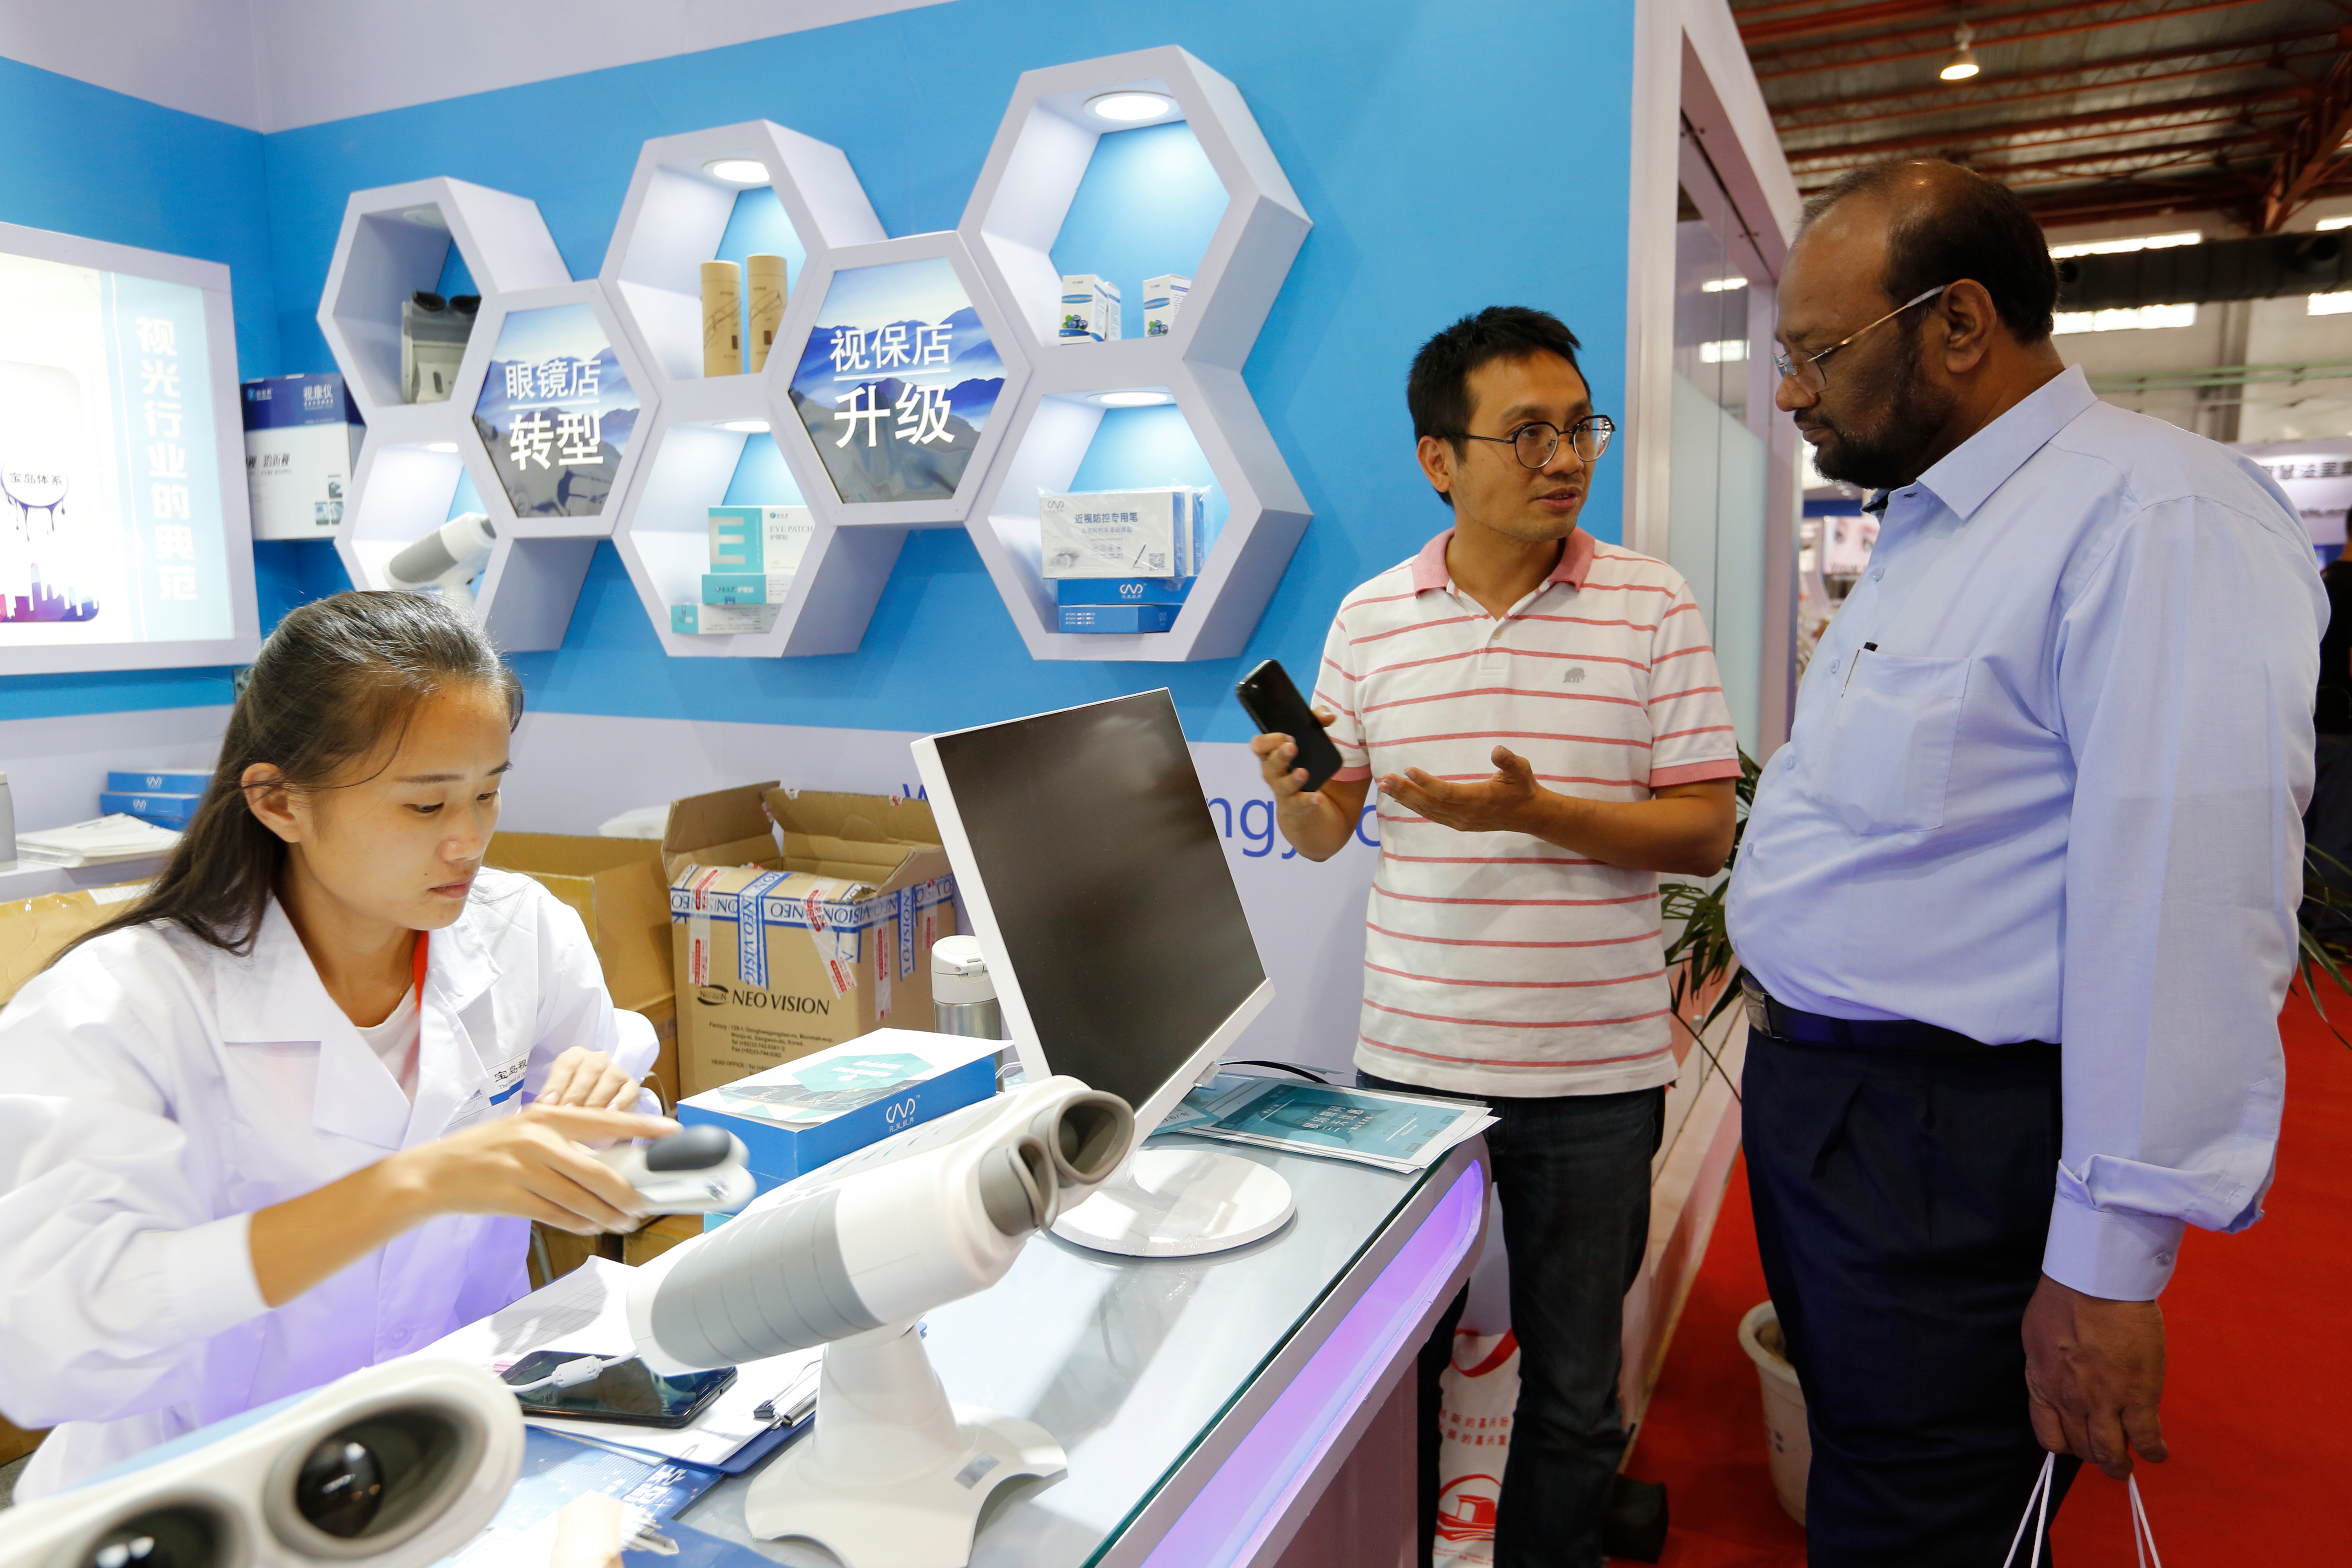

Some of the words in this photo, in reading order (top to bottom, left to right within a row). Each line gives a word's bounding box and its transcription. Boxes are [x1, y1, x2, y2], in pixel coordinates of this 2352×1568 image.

[830, 322, 953, 372] 视保店
[505, 359, 602, 402] 眼镜店
[833, 381, 956, 448] 升级
[508, 410, 604, 471] 转型
[136, 316, 198, 600] 视光行业的典范
[9, 472, 62, 486] 宝岛体系
[1075, 512, 1138, 524] 近视防控专用笔
[732, 989, 767, 1008] NEO
[771, 993, 830, 1015] VISION
[494, 1059, 527, 1082] 宝岛视
[1322, 1108, 1364, 1133] 三天优惠
